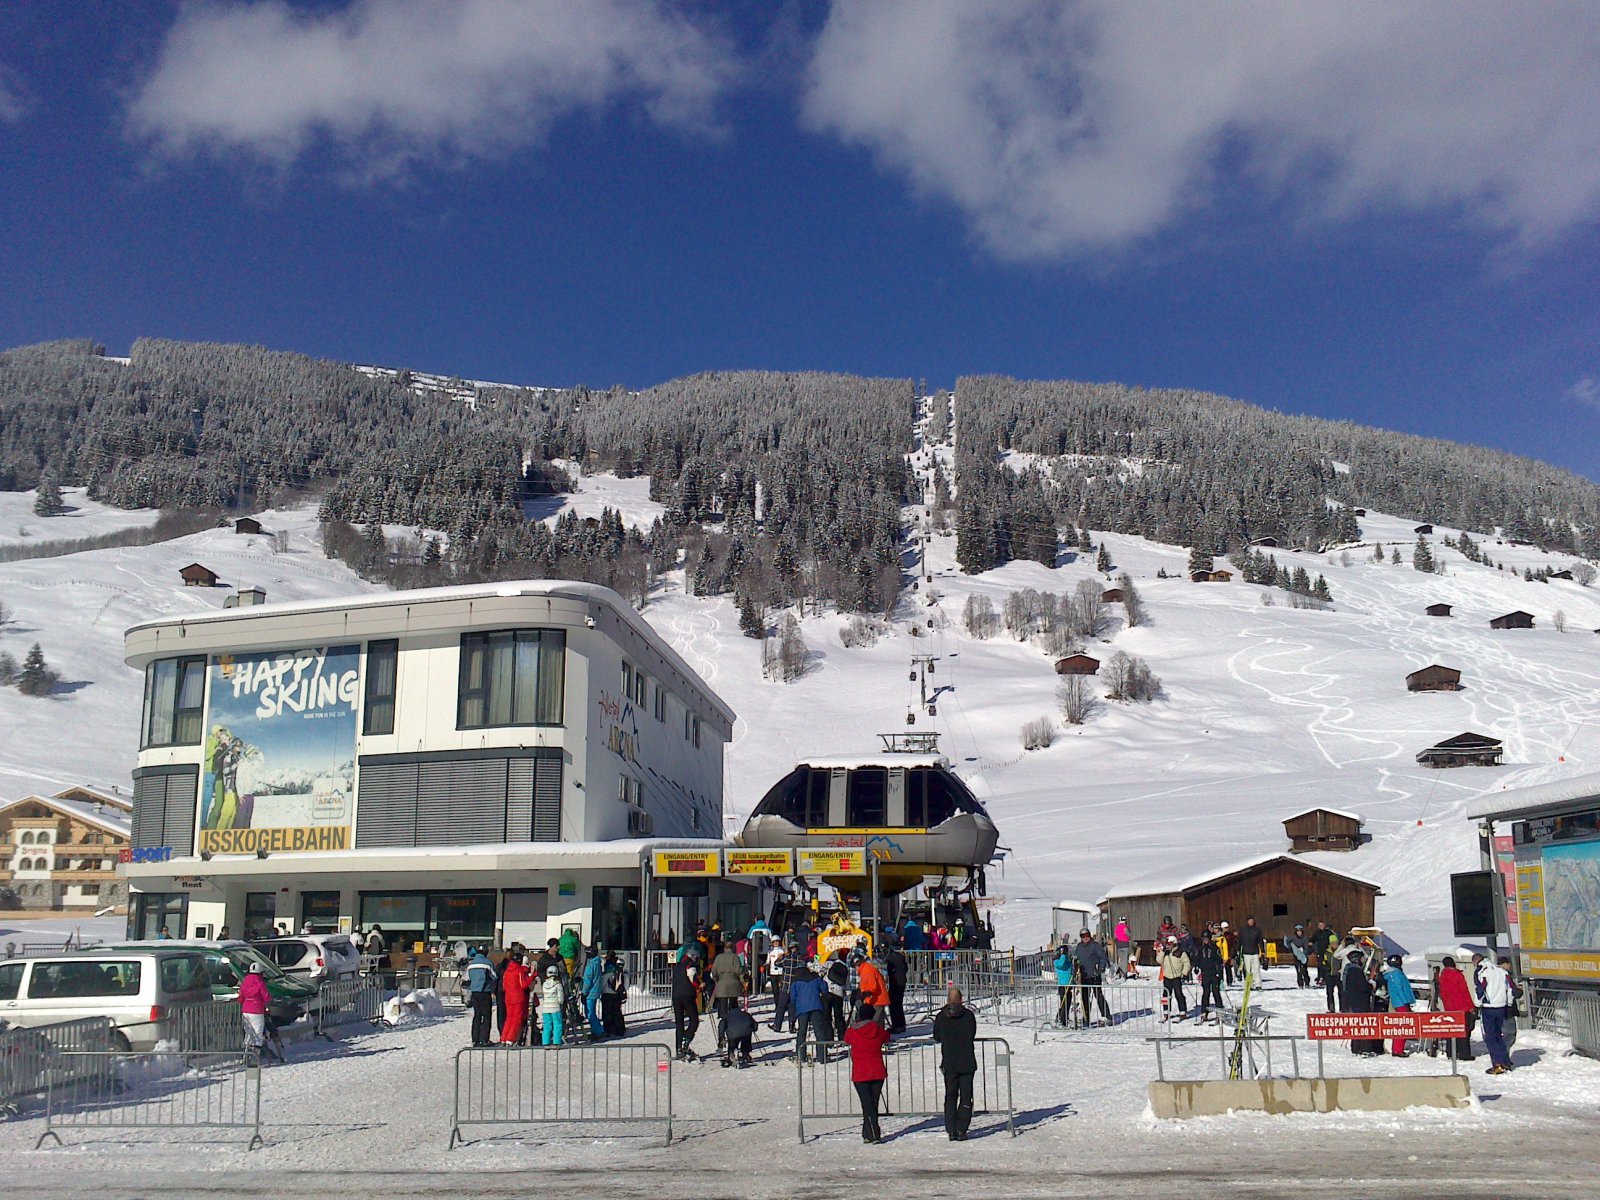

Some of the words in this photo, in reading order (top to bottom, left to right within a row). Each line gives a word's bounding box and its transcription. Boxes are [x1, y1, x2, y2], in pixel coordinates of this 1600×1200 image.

[232, 647, 328, 698] HAPPY
[256, 670, 359, 720] SKIING
[204, 827, 346, 852] ISSKOGELBAHN
[1310, 1017, 1377, 1027] TAGESPARKPLATZ
[1383, 1016, 1414, 1026] Camping
[1314, 1029, 1327, 1037] von
[1328, 1028, 1343, 1037] 8.00
[1350, 1028, 1369, 1036] 18.00
[1371, 1028, 1375, 1036] h
[1382, 1027, 1416, 1036] verboten!
